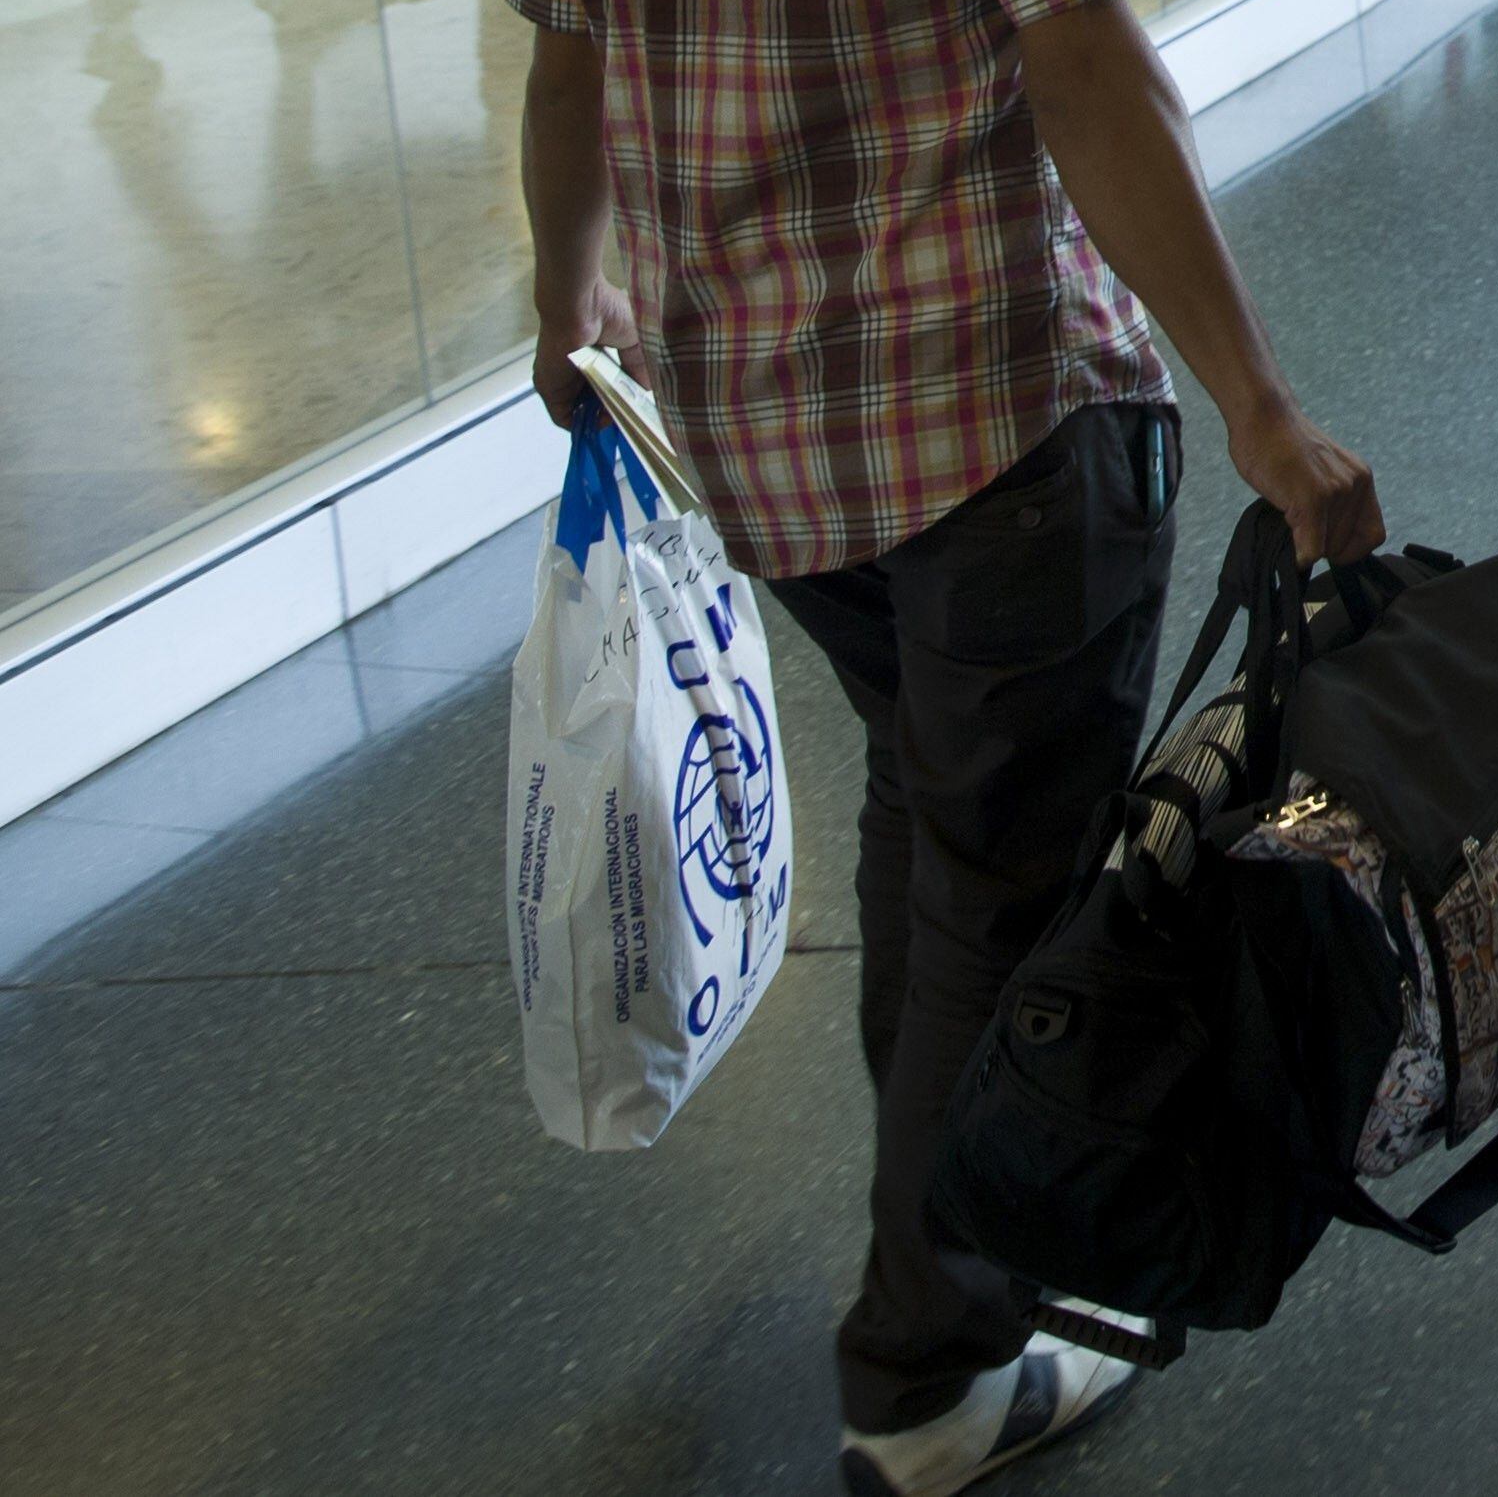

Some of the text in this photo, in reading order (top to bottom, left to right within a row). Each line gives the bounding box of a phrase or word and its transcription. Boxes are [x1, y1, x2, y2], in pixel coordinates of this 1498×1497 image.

[517, 762, 546, 897] INTERNATIONALE
[532, 805, 555, 902] MIGRATIONS
[527, 904, 539, 935] LES
[604, 787, 630, 1023] ORGANIZACIÓN INTERNACIONAL
[624, 812, 650, 993] PARA LAS MIGRACIONES
